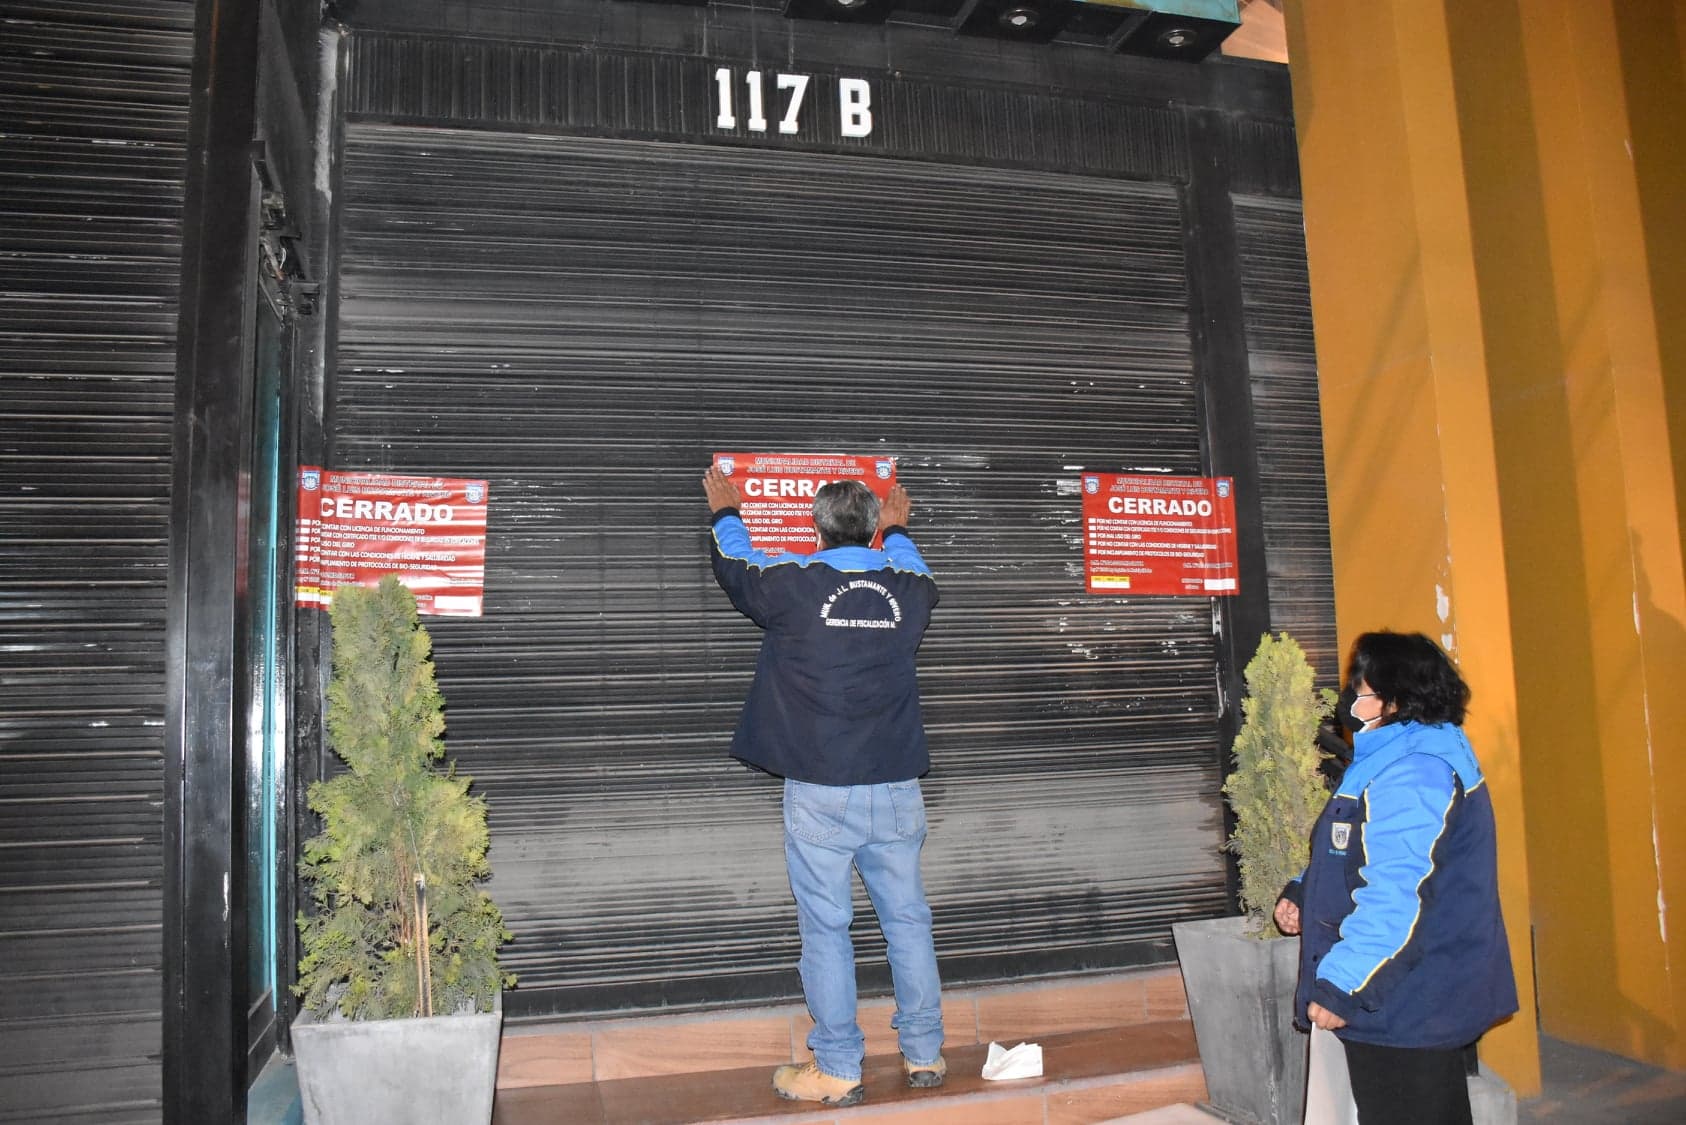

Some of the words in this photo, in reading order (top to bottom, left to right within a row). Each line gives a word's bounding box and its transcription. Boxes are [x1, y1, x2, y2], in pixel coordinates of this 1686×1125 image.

[715, 68, 810, 135] 117
[839, 78, 873, 137] B
[320, 496, 454, 523] CERRADO
[1108, 496, 1212, 517] CERRADO
[340, 524, 352, 532] CON
[352, 525, 374, 534] LICENCIA
[382, 527, 425, 535] FUNCIONAMIENTO
[342, 541, 355, 549] GIRO
[358, 561, 392, 569] PROTOCOLOS
[849, 580, 888, 596] BUSTAMANTE
[828, 594, 837, 602] de
[885, 592, 894, 600] Y
[888, 597, 902, 623] RIVERO
[825, 617, 849, 627] GERENCIA
[849, 618, 857, 628] DE
[857, 617, 890, 629] FISCALIZACIÓN
